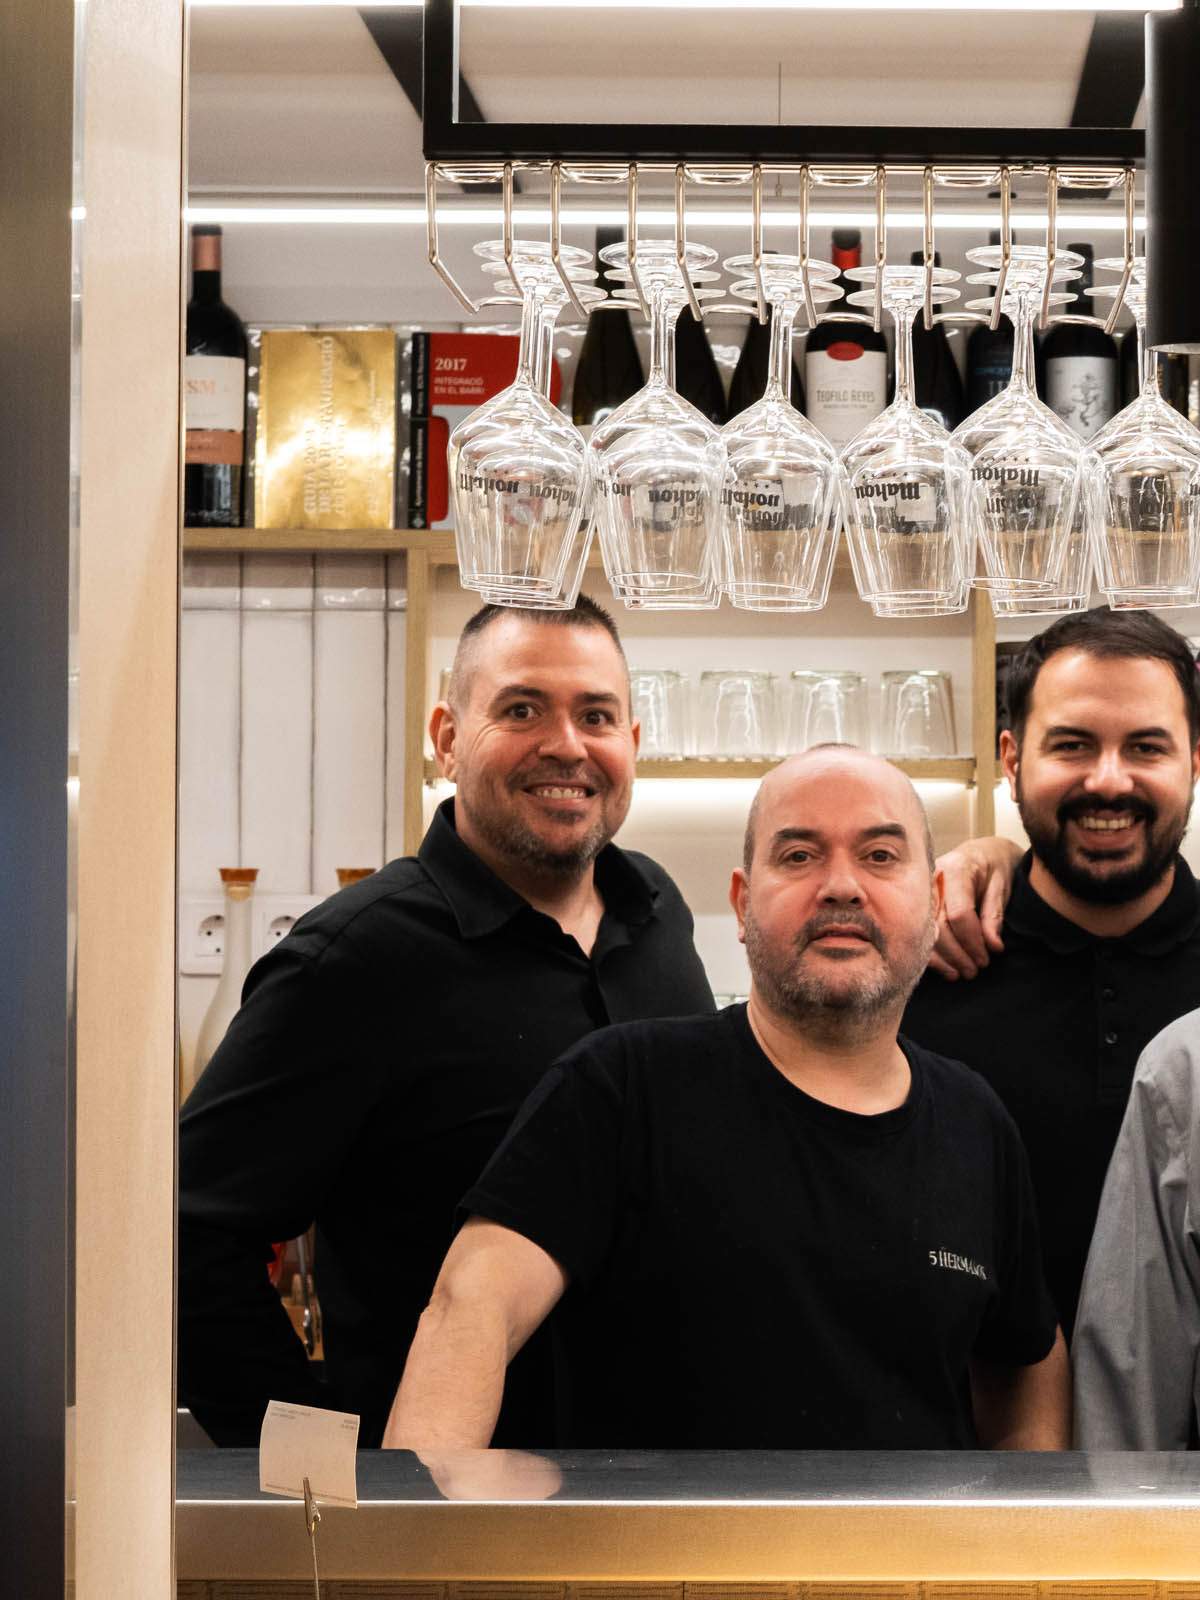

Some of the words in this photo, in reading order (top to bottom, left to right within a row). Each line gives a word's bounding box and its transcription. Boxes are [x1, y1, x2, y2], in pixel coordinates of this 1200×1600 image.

[434, 357, 468, 371] 2017
[970, 467, 1040, 487] Mahou
[854, 482, 921, 502] Mahou
[928, 1250, 938, 1266] 5
